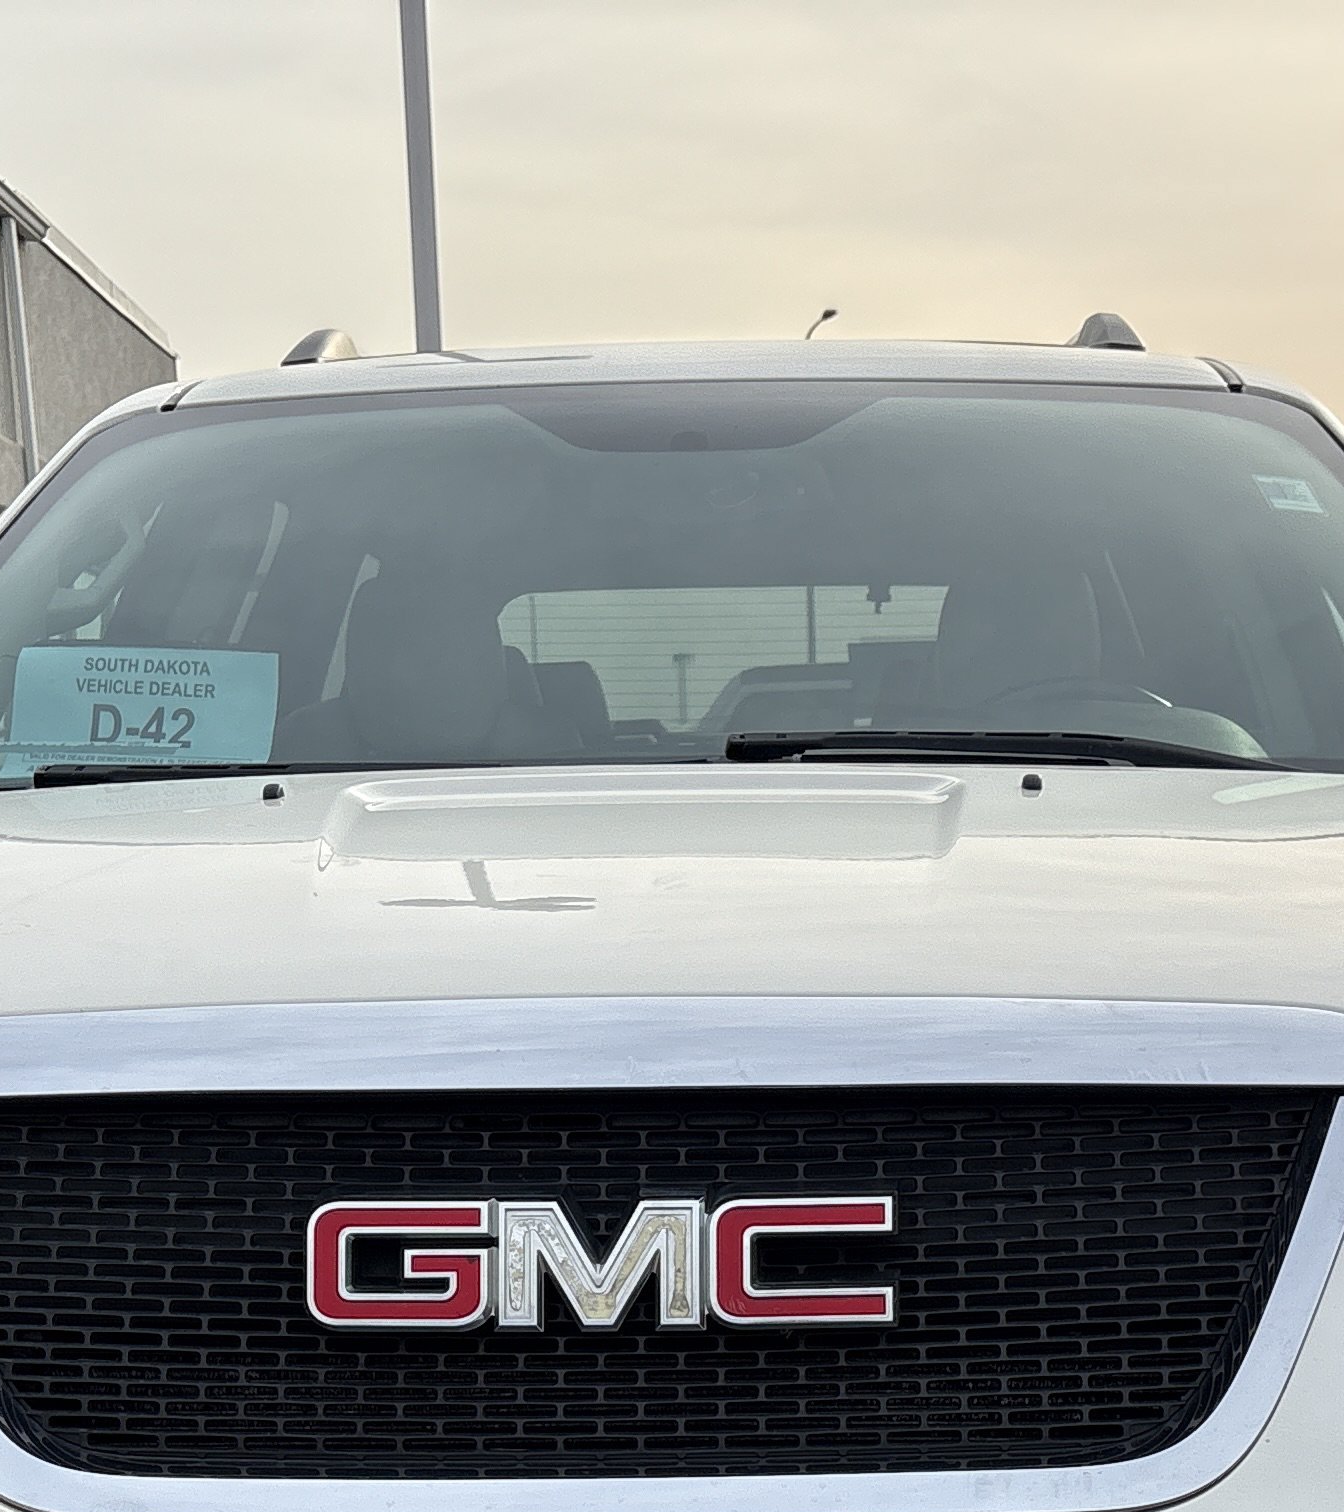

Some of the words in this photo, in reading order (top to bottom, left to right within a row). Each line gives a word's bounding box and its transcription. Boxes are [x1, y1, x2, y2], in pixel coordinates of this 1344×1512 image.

[84, 657, 139, 673] SOUTH
[144, 659, 211, 676] DAKOTA
[76, 678, 144, 695] VEHICLE
[149, 682, 216, 698] DEALER
[90, 703, 196, 748] D-42
[306, 1195, 895, 1331] GMC
